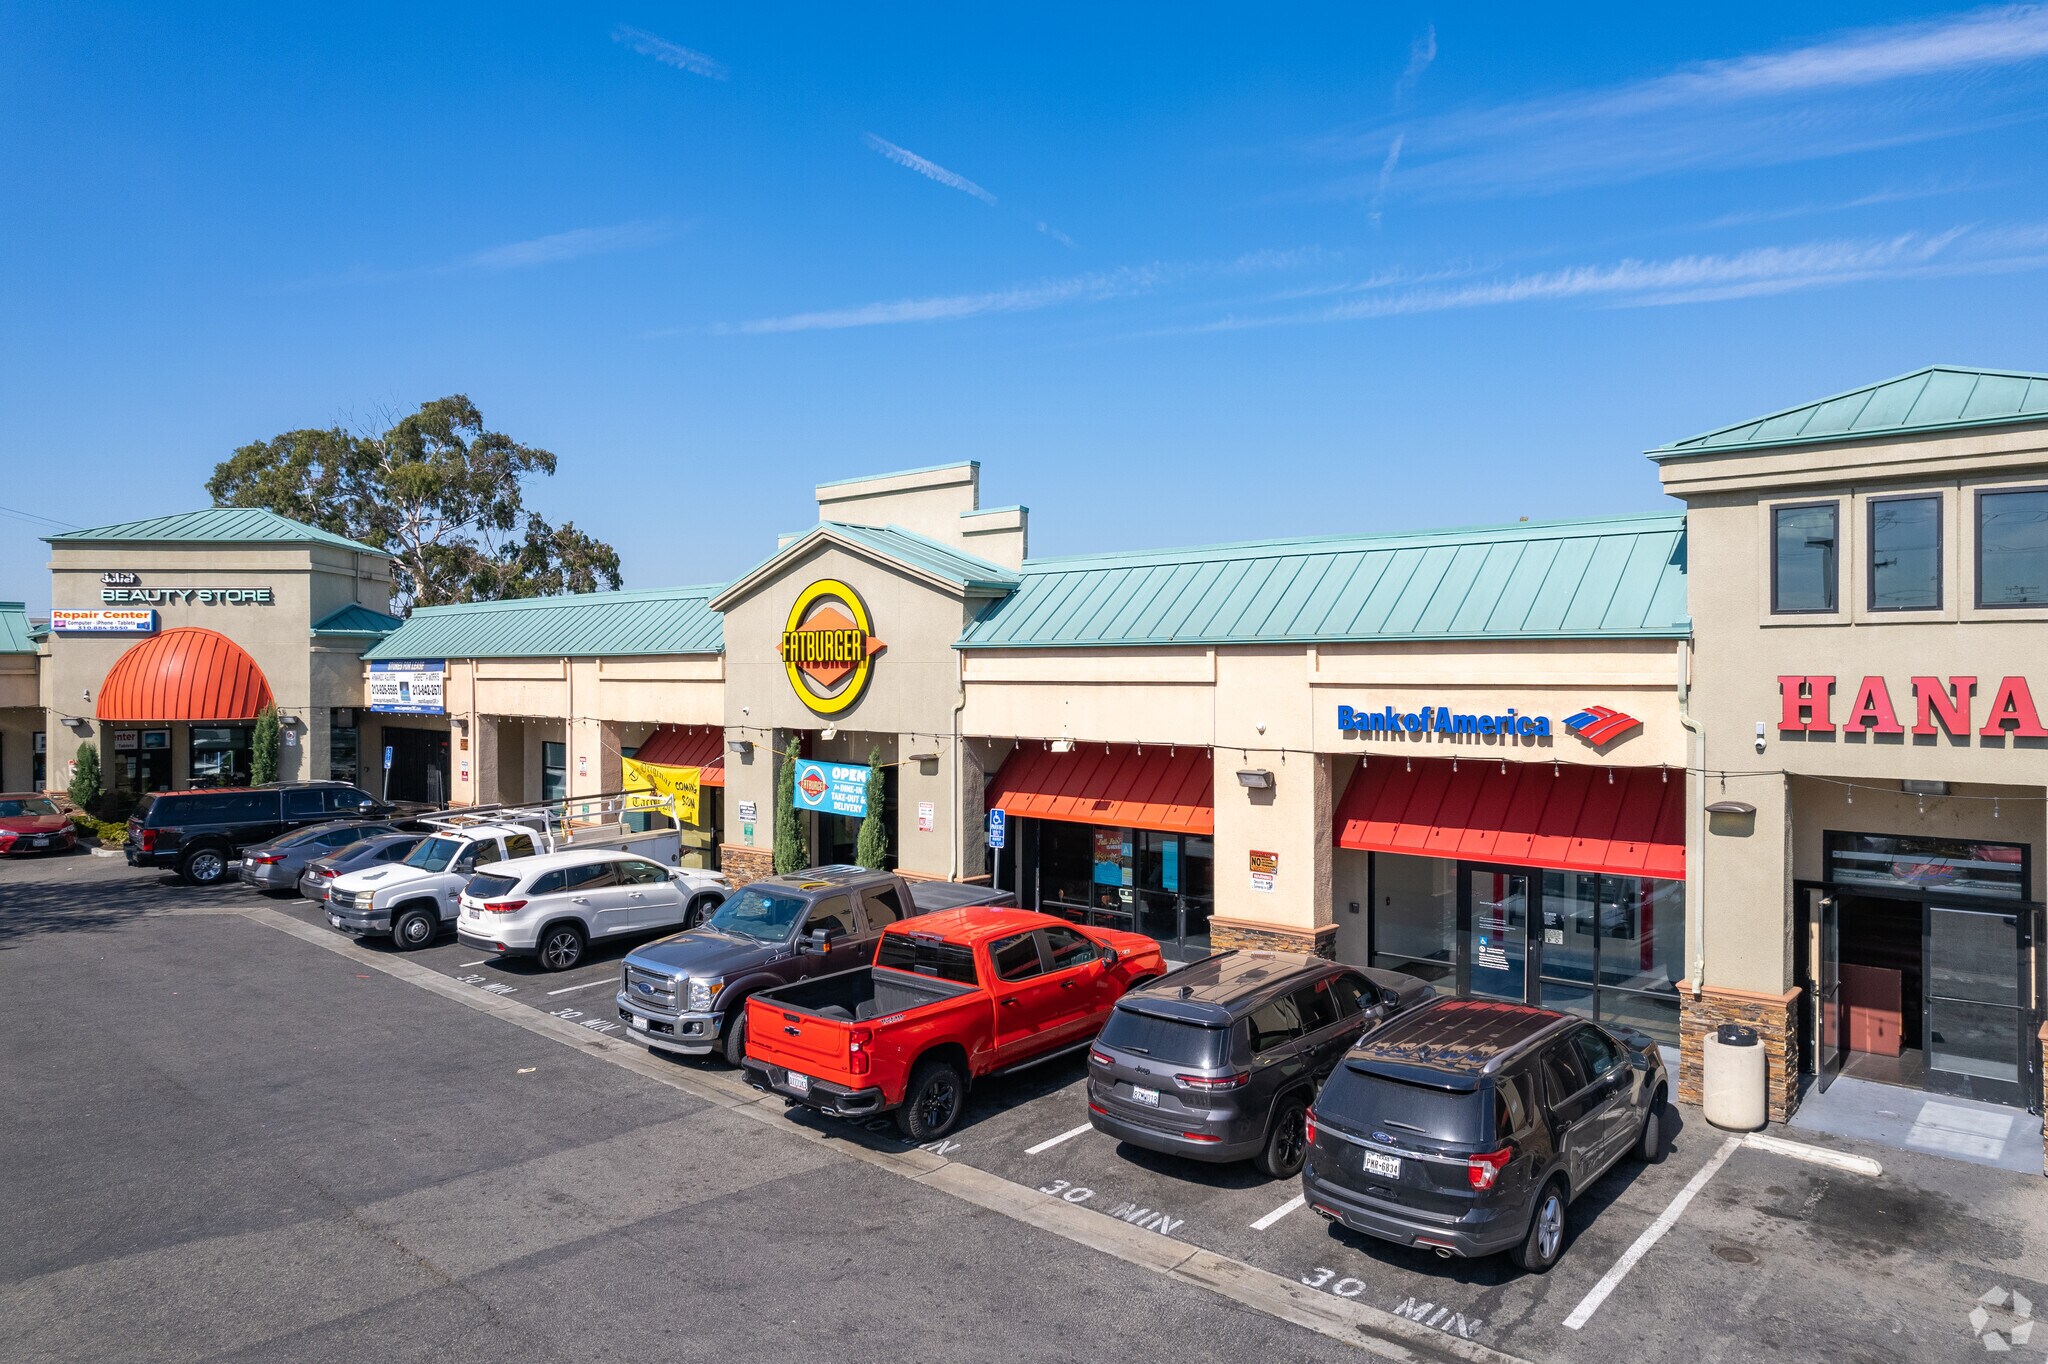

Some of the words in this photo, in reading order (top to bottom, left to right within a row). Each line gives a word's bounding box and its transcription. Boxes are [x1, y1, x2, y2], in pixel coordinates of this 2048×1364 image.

[101, 589, 192, 602] BEAUTY
[197, 589, 270, 602] STORE
[53, 610, 99, 620] Repair
[102, 611, 150, 619] Center
[782, 629, 862, 662] FATBURGER
[411, 661, 425, 671] LEASE
[1777, 675, 2048, 737] HANA
[1337, 705, 1401, 731] Bank
[1402, 706, 1432, 733] of
[1433, 706, 1551, 737] America
[831, 766, 867, 783] OPEN
[674, 781, 698, 794] COMING
[840, 784, 863, 795] DINE-IN
[831, 792, 860, 803] TAKE-OUT
[833, 802, 863, 813] DELIVERY
[1251, 857, 1261, 867] NO
[457, 974, 487, 984] 30
[481, 982, 518, 995] MIN
[550, 1007, 583, 1019] 30
[580, 1018, 621, 1032] MIN
[1039, 1179, 1097, 1203] 30
[1107, 1201, 1185, 1235] MIN
[1300, 1266, 1367, 1298] 30
[1391, 1295, 1483, 1339] MIN
